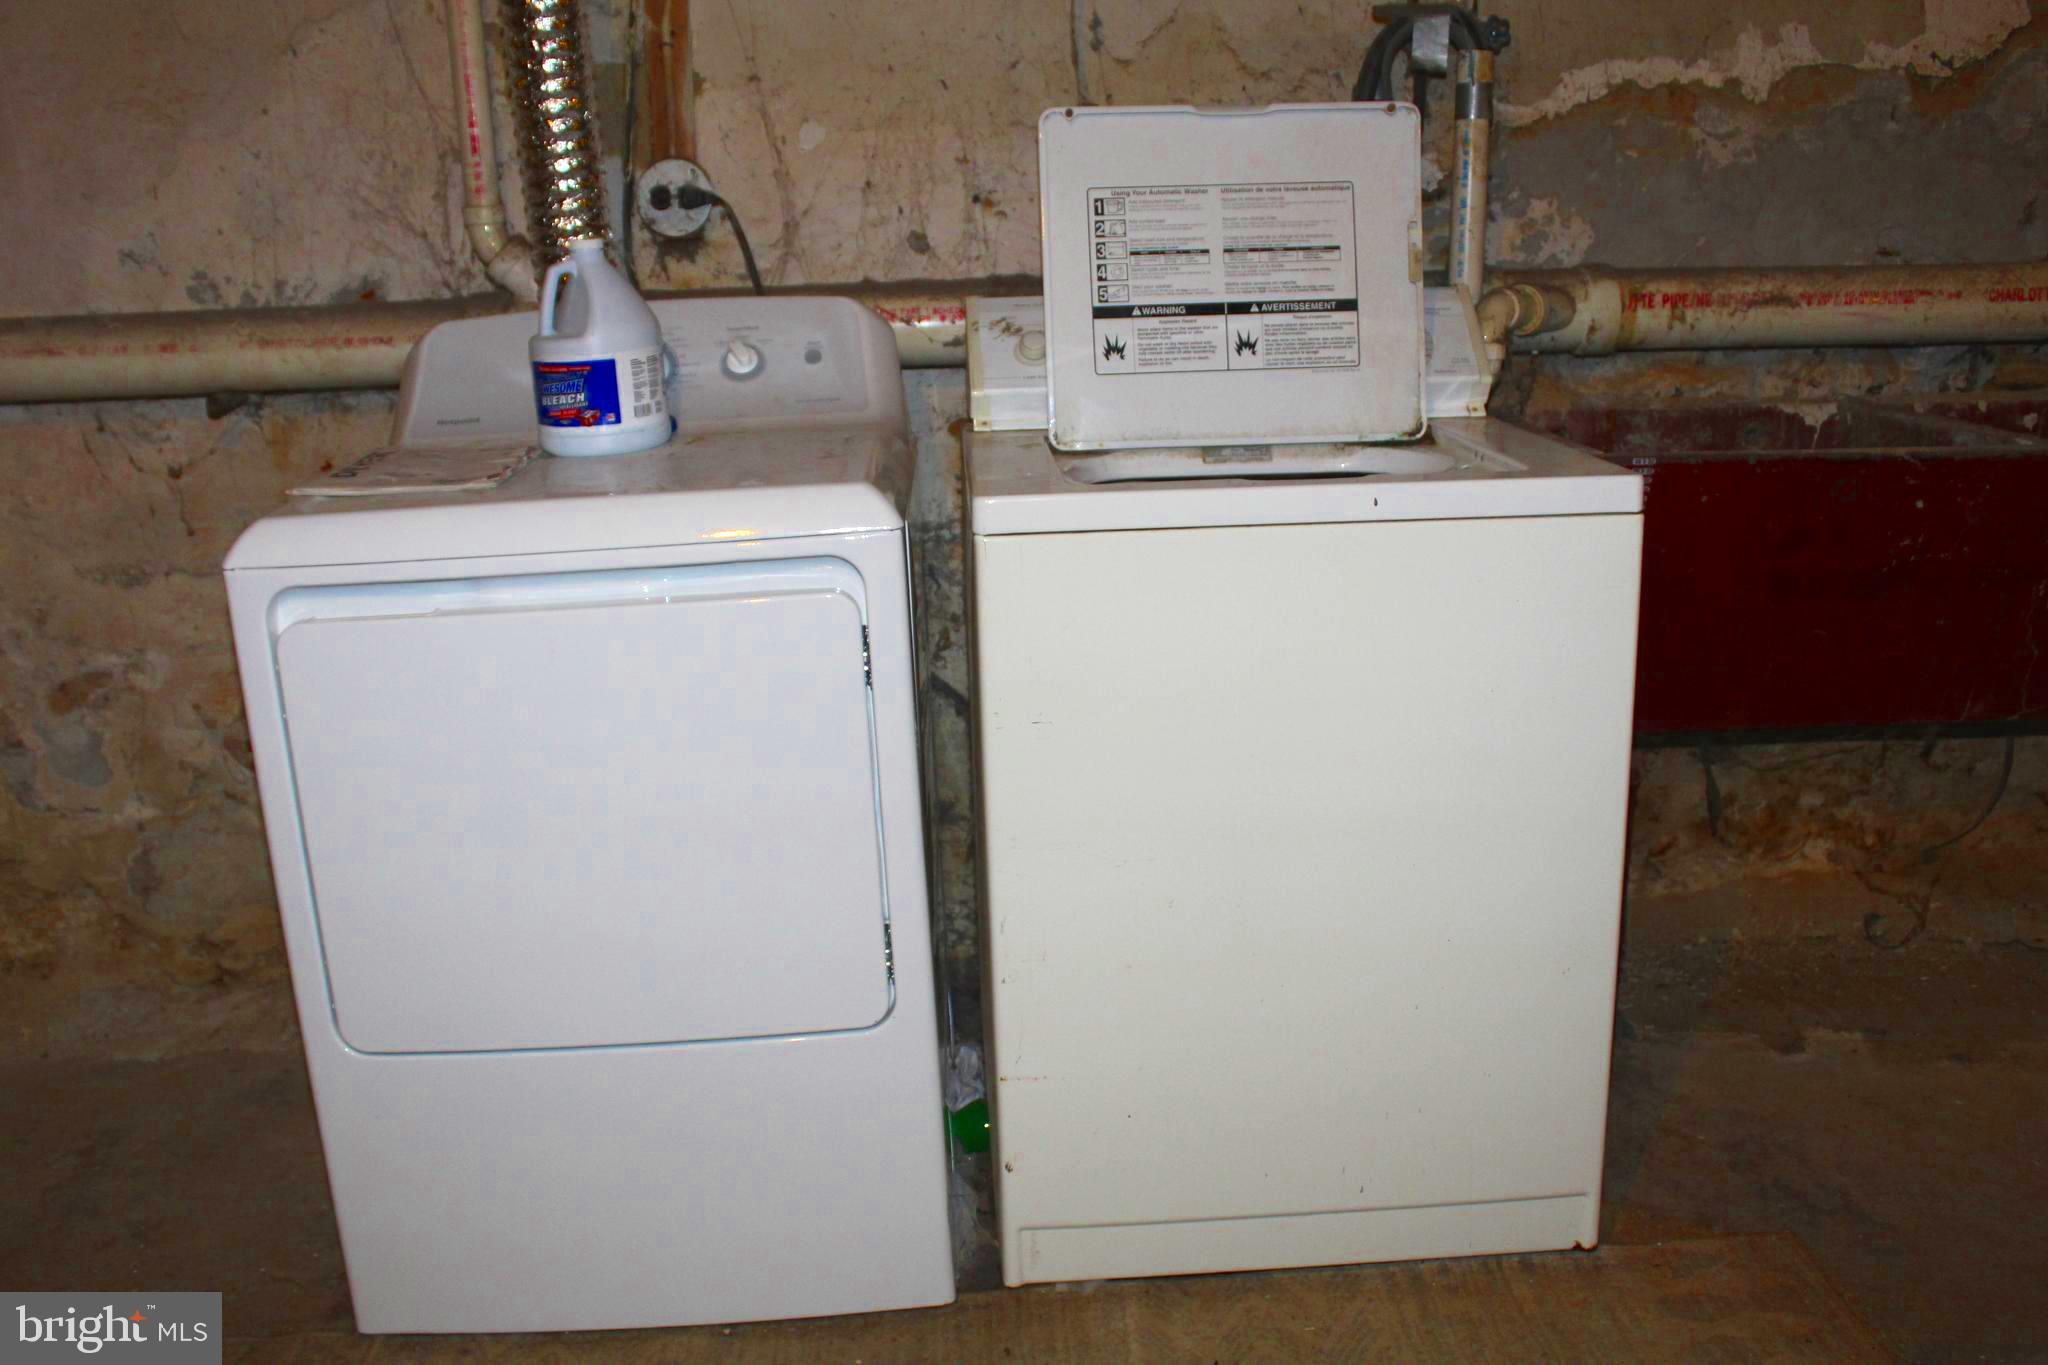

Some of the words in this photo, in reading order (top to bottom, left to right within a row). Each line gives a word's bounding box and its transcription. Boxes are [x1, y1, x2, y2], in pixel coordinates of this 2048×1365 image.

[1095, 222, 1104, 236] 2
[1096, 243, 1105, 258] 3
[1097, 264, 1106, 279] 4
[1098, 285, 1108, 301] 5
[1141, 305, 1186, 315] WARNING
[1261, 301, 1337, 312] AVERTISSEMENT
[543, 377, 585, 393] WESOME
[541, 392, 586, 406] BLEACH
